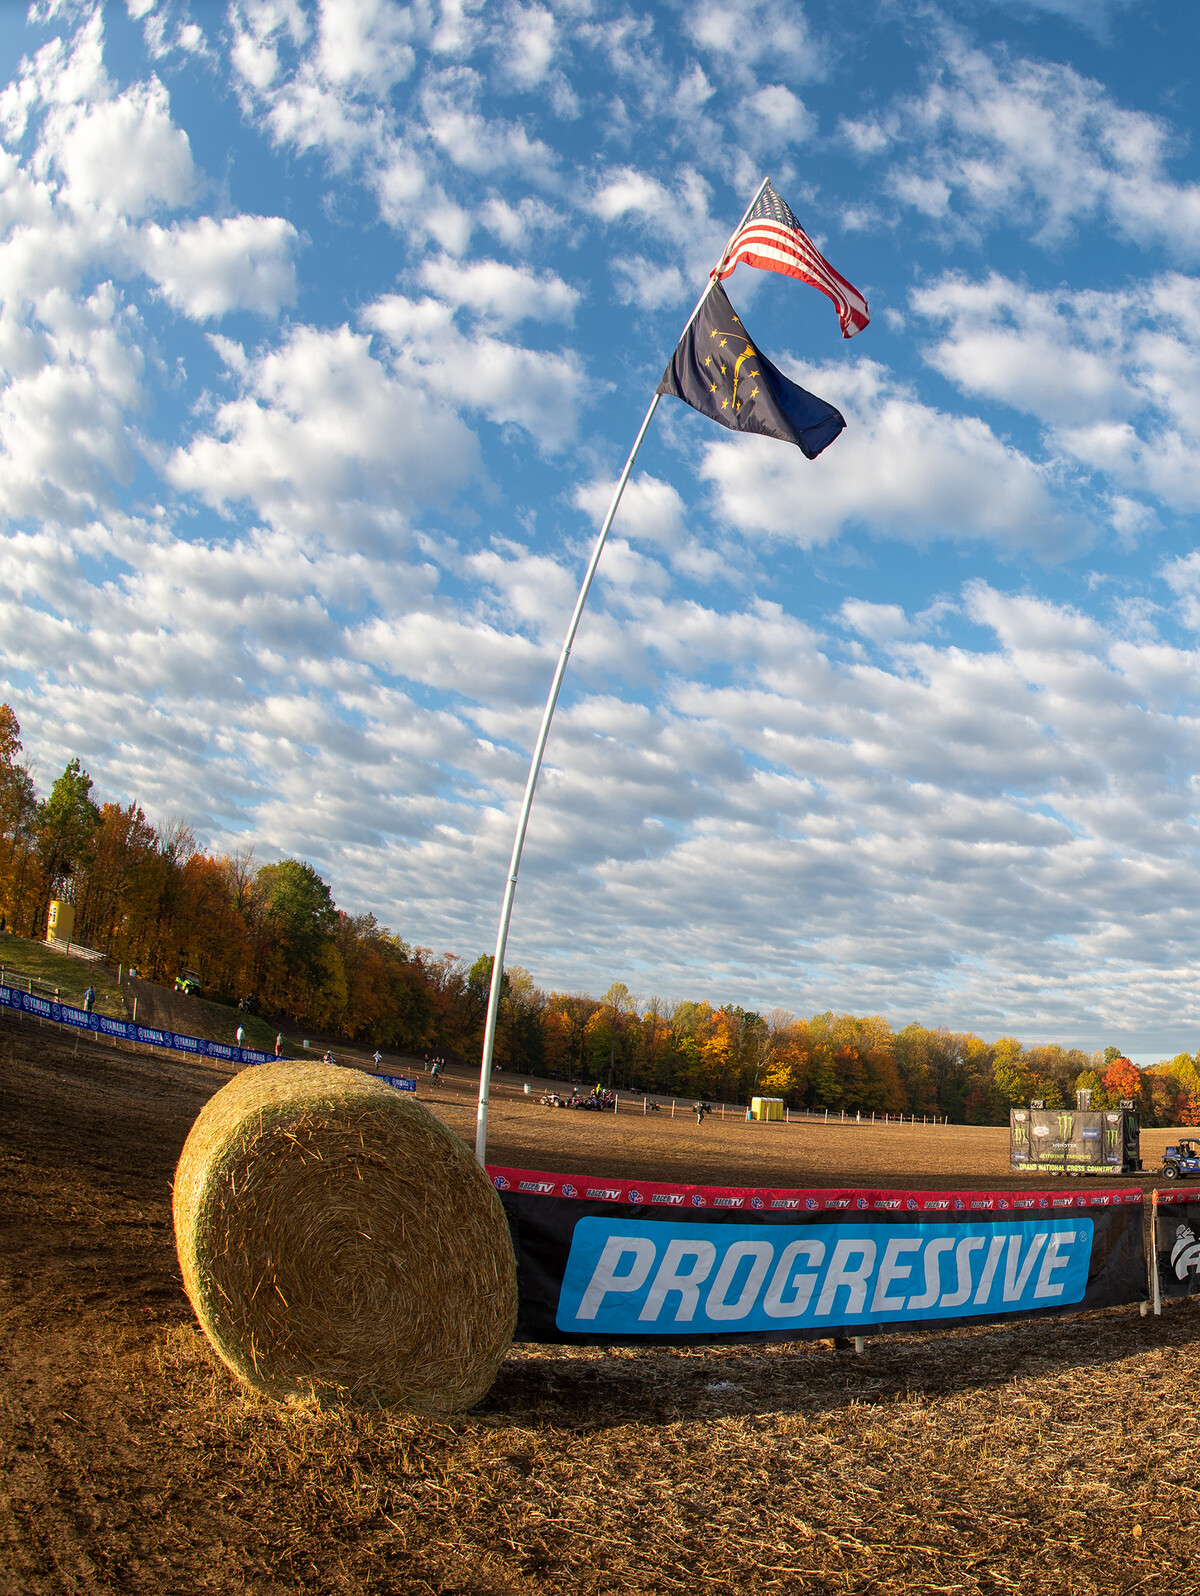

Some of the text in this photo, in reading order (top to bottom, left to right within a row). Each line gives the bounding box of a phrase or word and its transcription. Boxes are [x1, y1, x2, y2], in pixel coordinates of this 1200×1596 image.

[1038, 1163, 1065, 1172] NATIONAL
[1066, 1164, 1085, 1172] CROSS
[1087, 1165, 1113, 1173] COUNTRY
[574, 1231, 1077, 1322] PROGRESSIVE
